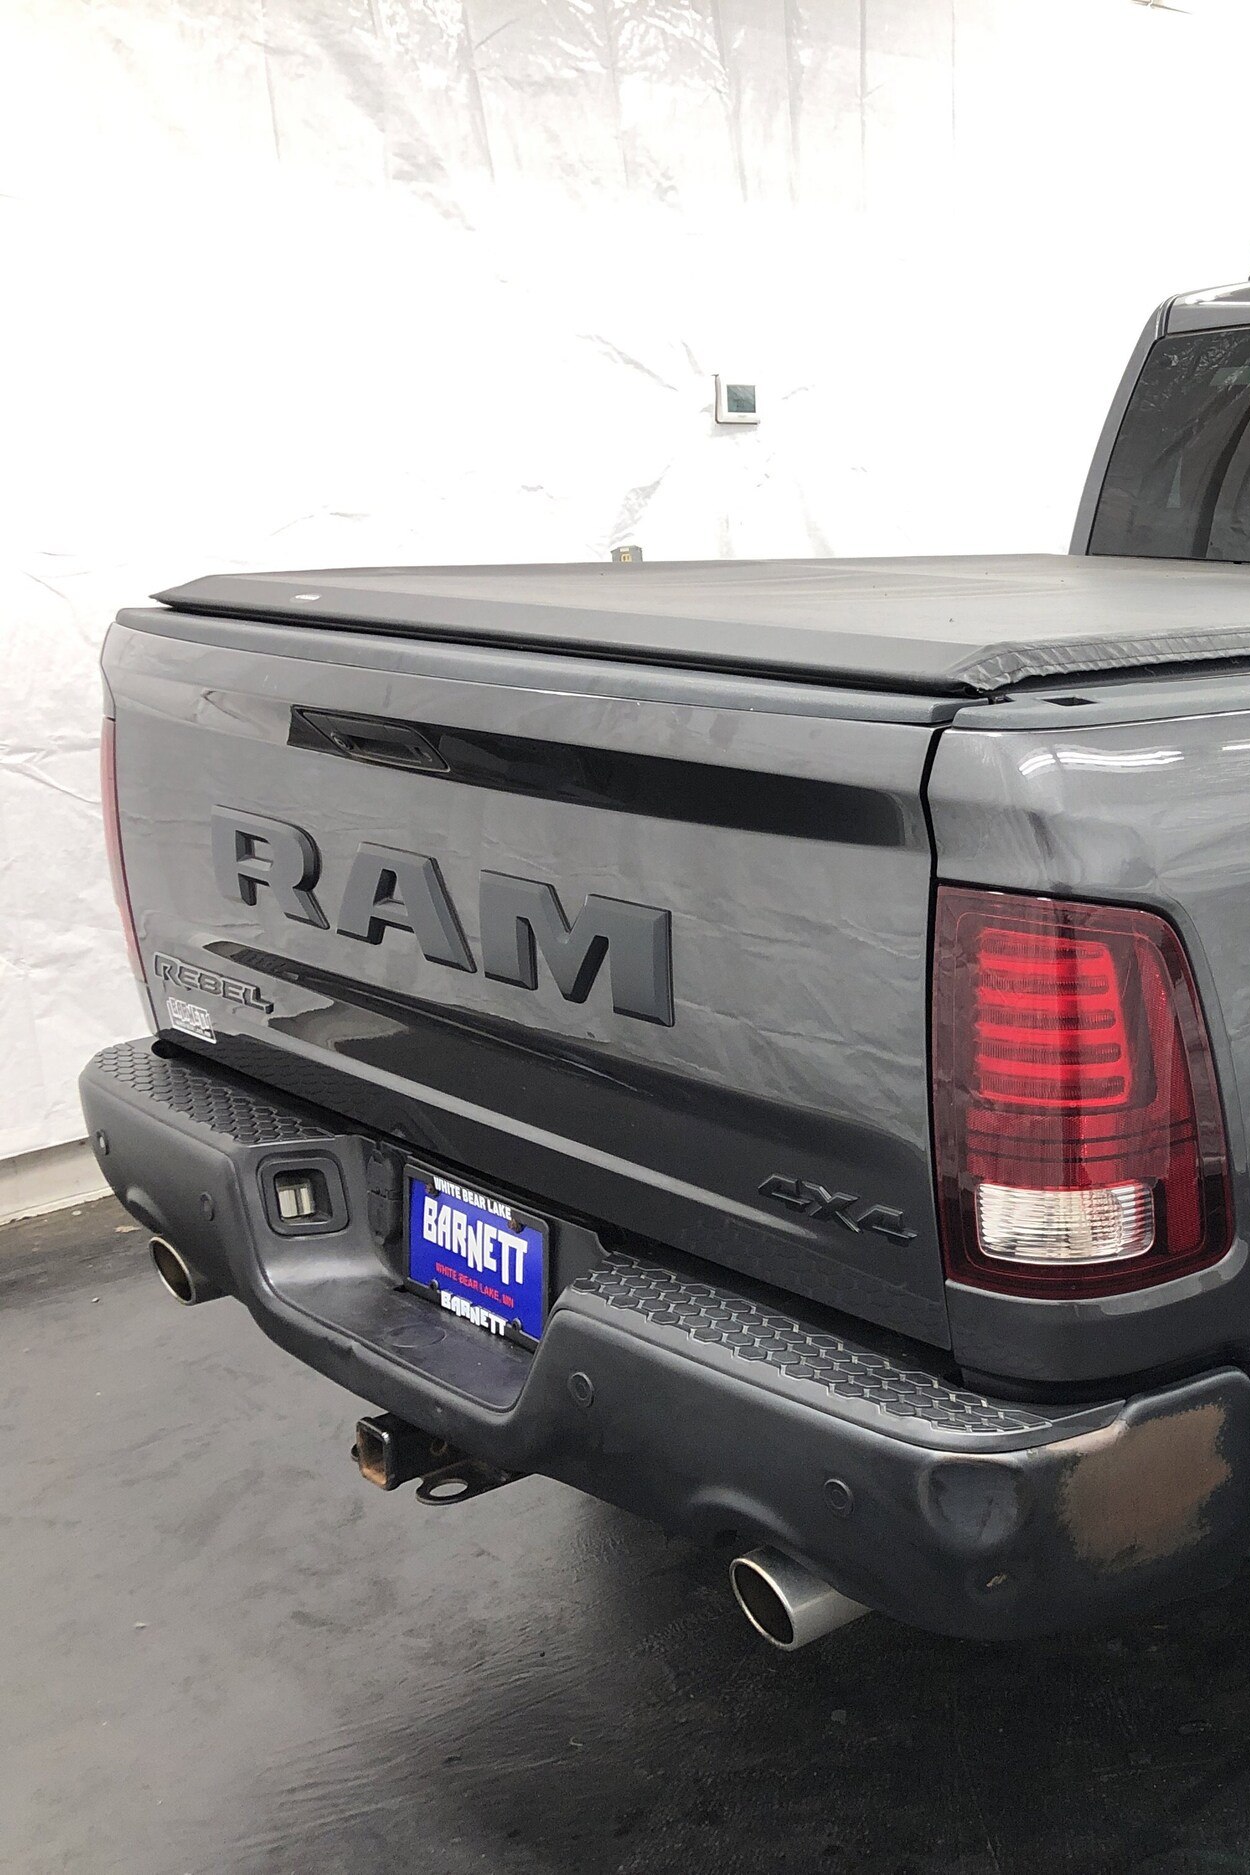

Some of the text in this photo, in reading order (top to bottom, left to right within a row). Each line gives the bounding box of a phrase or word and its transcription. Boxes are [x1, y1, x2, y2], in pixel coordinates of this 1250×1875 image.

[211, 803, 675, 1027] RAM
[153, 952, 274, 1014] REBEL
[433, 1176, 513, 1220] WHITE BEAR LAKE
[423, 1196, 528, 1285] BARNETT
[435, 1262, 458, 1282] WHITE
[458, 1272, 479, 1291] BEAR
[502, 1293, 514, 1309] MN
[440, 1290, 509, 1336] BARNETT
